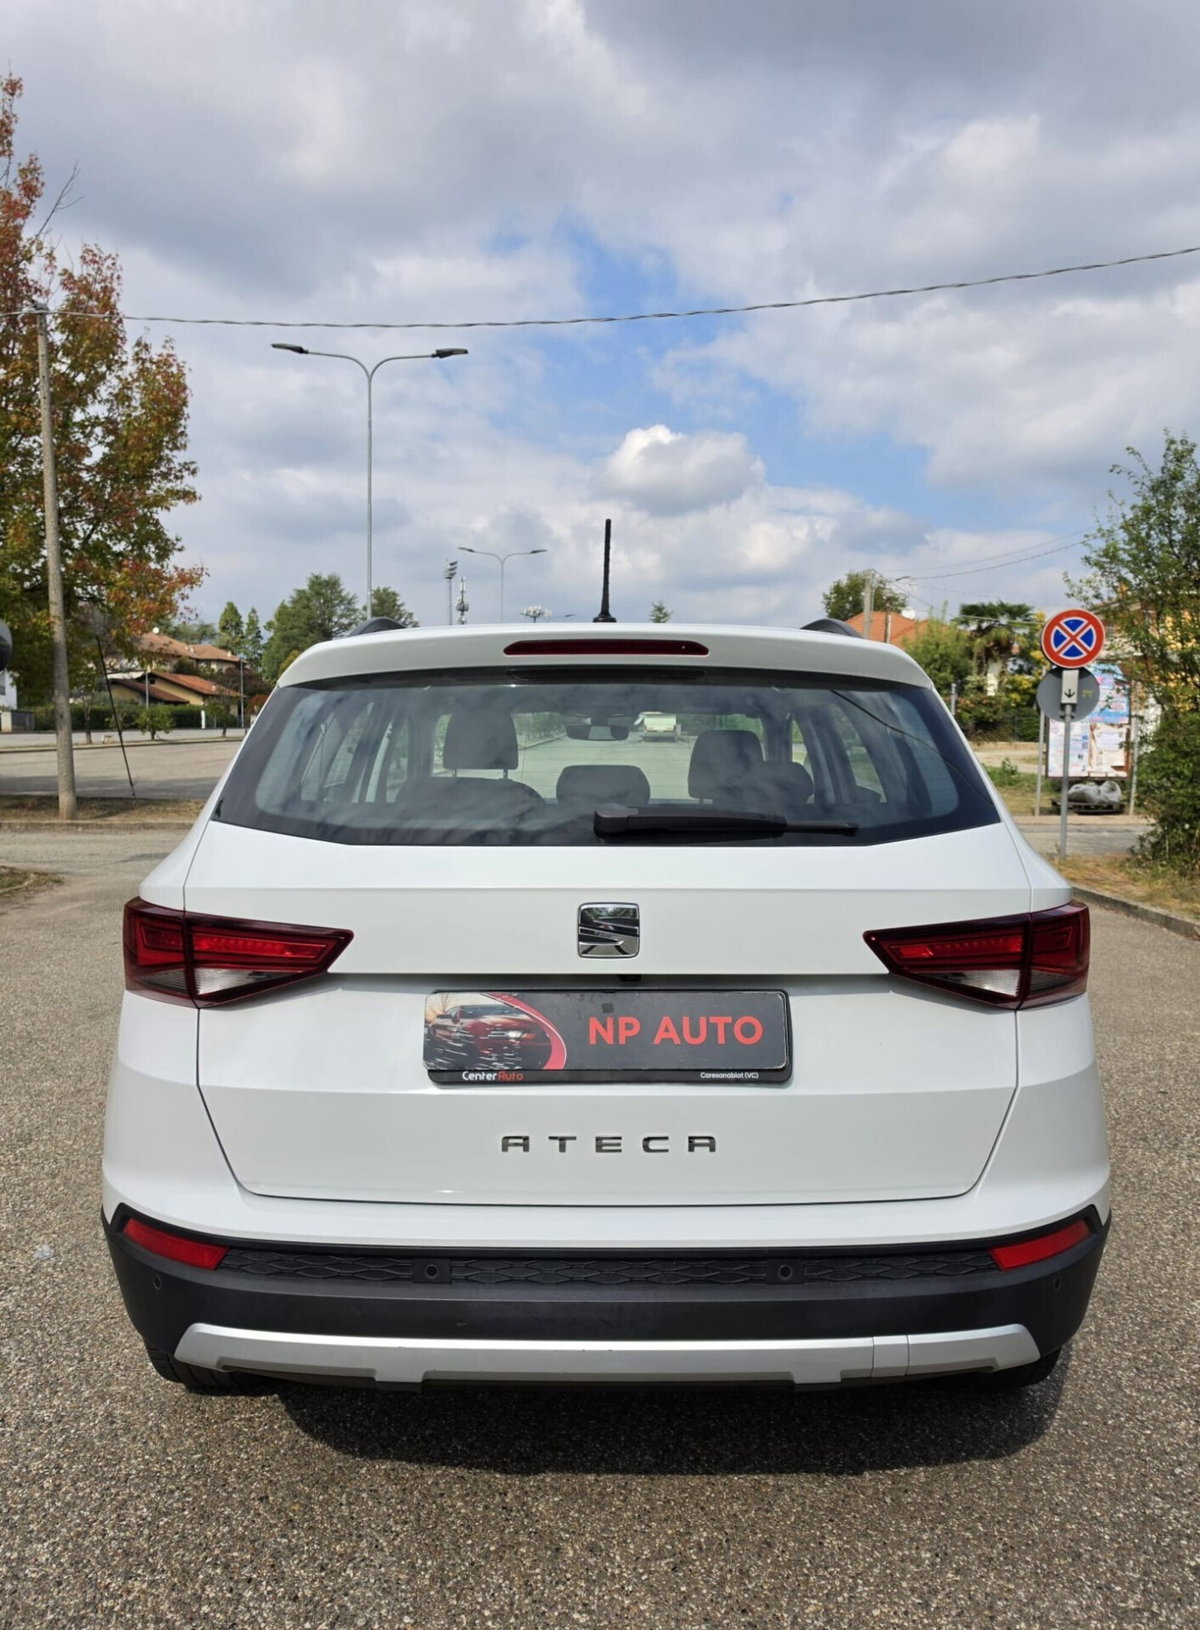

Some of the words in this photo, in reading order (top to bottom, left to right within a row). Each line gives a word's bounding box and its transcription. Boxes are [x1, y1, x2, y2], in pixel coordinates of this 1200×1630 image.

[588, 1016, 641, 1045] NP
[652, 1015, 763, 1046] AUTO
[744, 1071, 760, 1080] (VC)
[501, 1135, 717, 1153] ATECA
